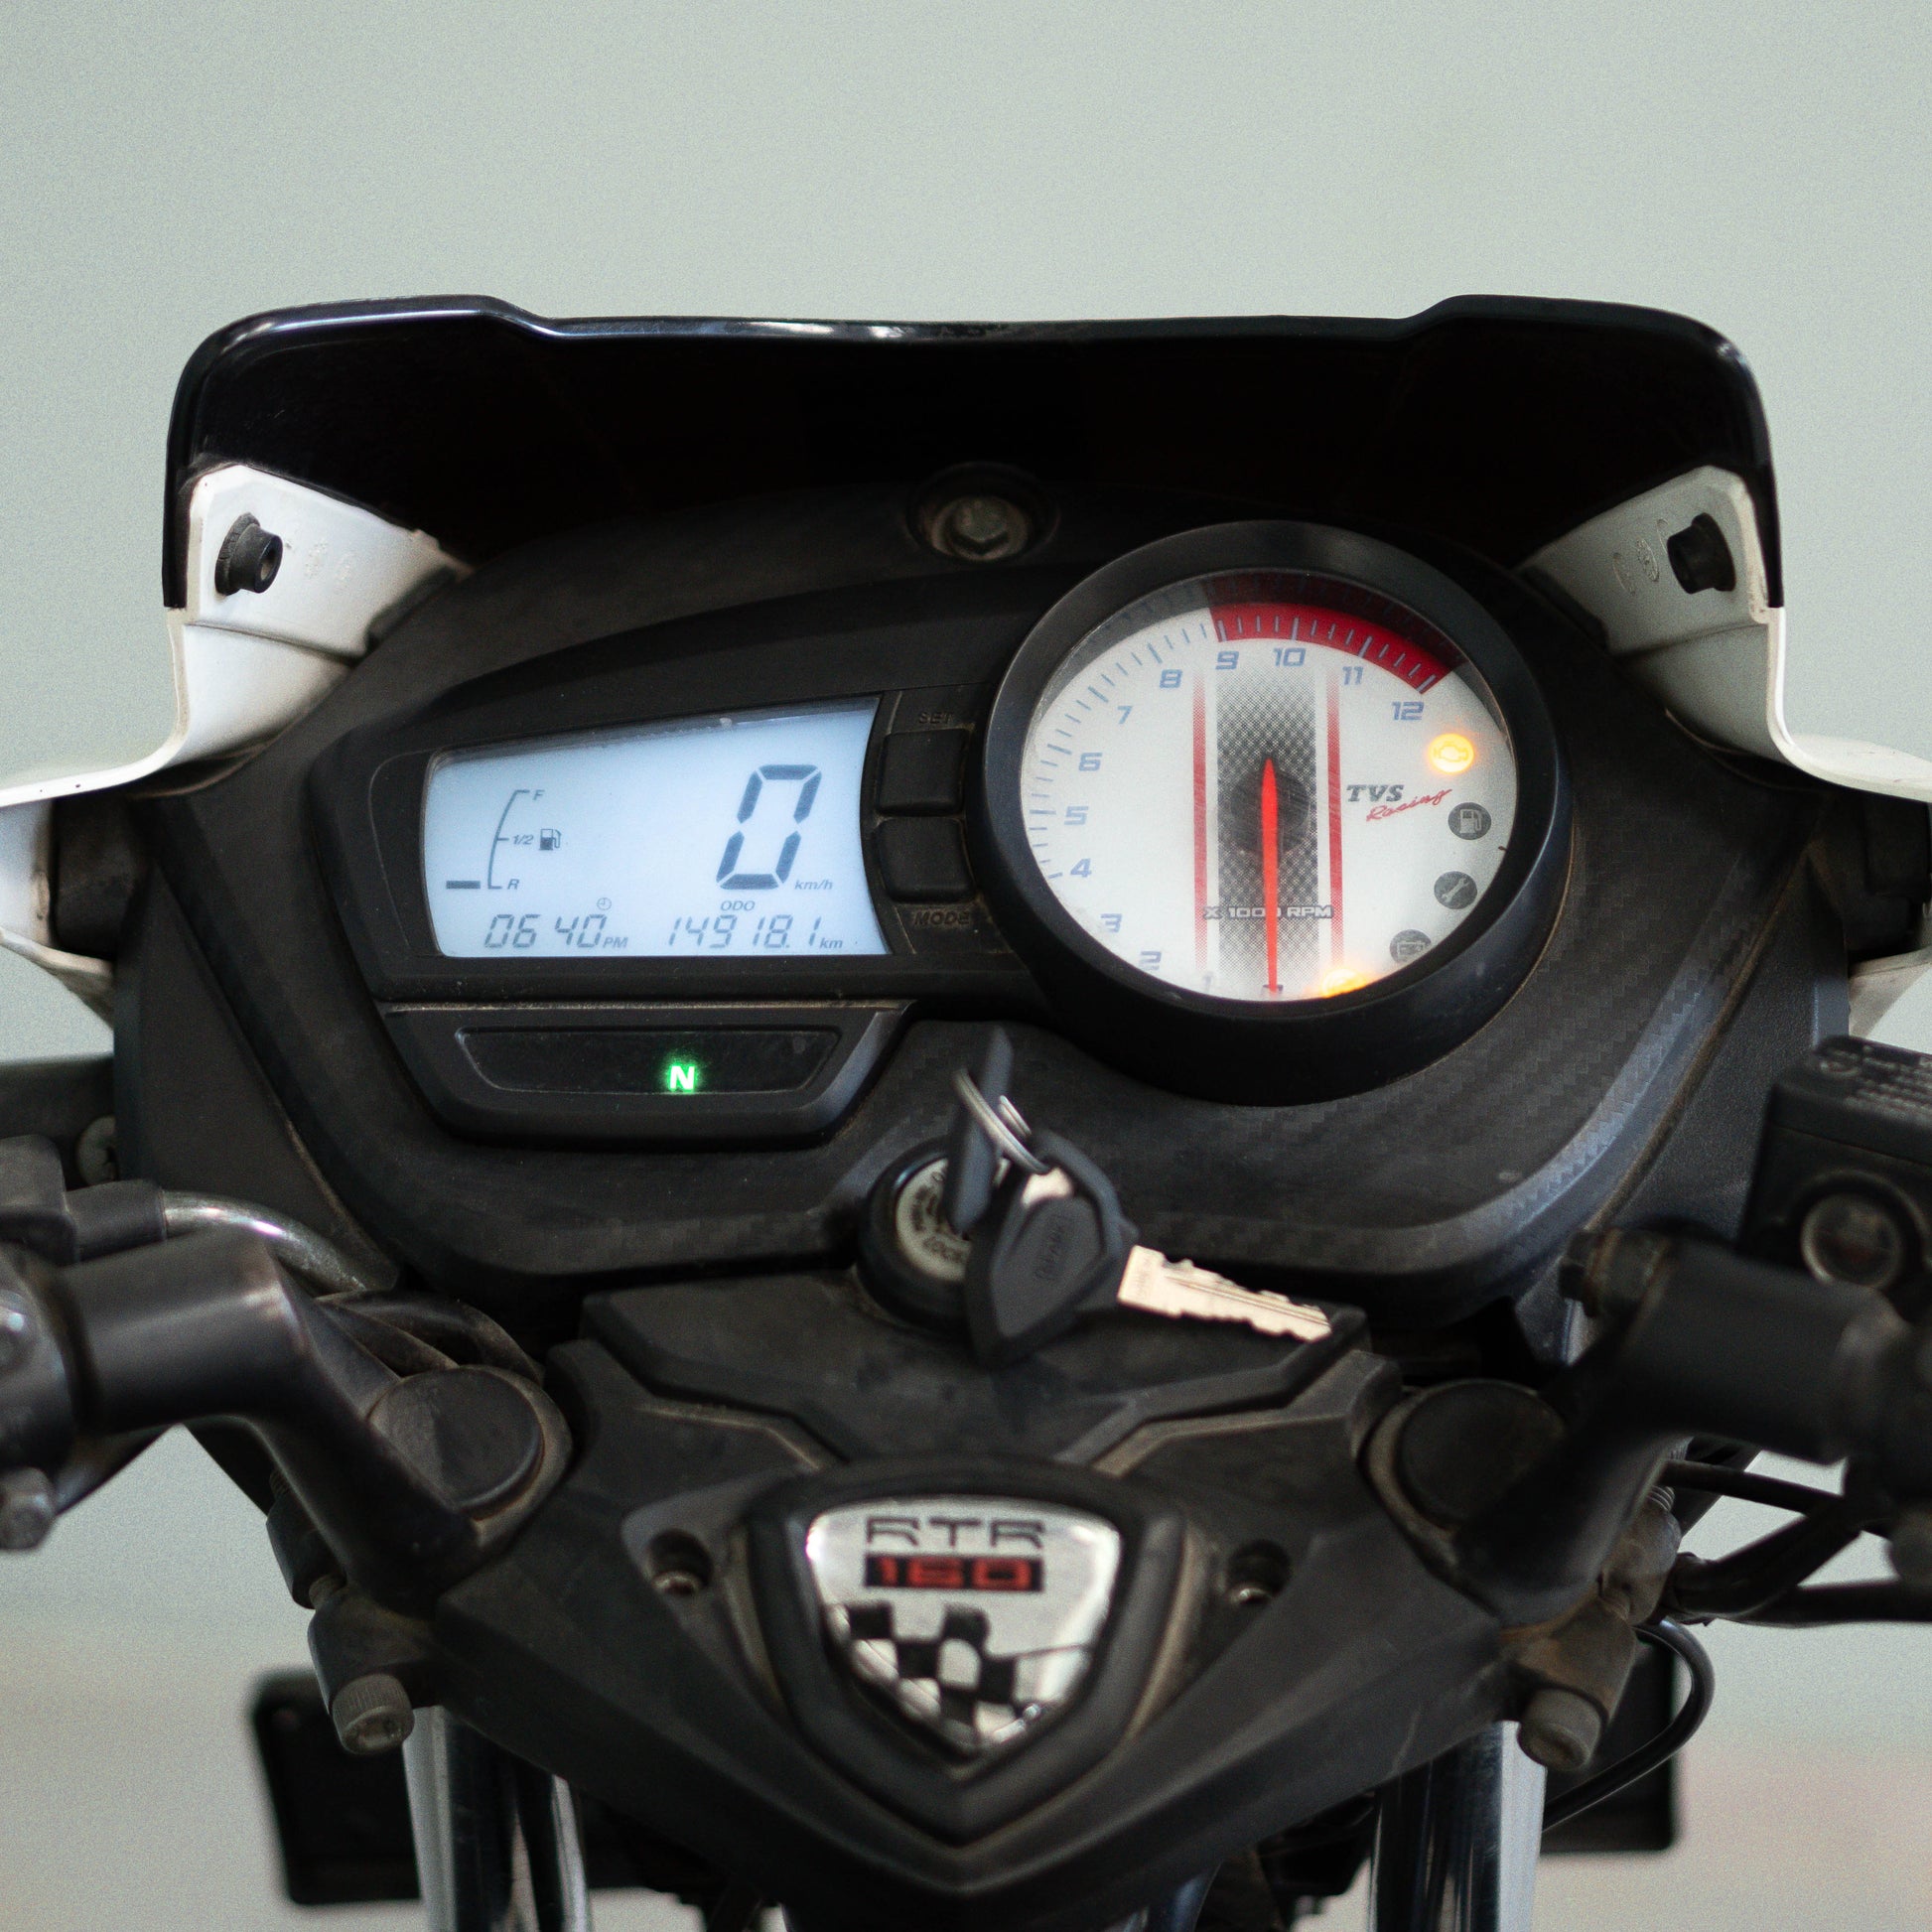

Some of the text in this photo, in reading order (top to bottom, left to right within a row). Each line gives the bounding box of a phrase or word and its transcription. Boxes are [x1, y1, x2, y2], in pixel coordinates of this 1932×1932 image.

[1214, 650, 1240, 670] 9
[1273, 647, 1307, 667] 10
[1159, 669, 1182, 689] 8
[1341, 666, 1364, 686] 11
[1117, 706, 1134, 725] 7
[1391, 701, 1425, 721] 12
[1078, 752, 1103, 771] 6
[532, 790, 544, 801] F
[1346, 784, 1404, 802] TVS
[1366, 788, 1452, 821] Racing
[1064, 806, 1089, 826] 5
[716, 763, 823, 891] 0
[512, 835, 534, 845] 1/2
[1069, 859, 1092, 878] 4
[507, 880, 519, 891] R
[794, 879, 834, 893] km/h
[720, 900, 756, 911] ODO
[1203, 904, 1333, 919] X 100 RPM
[914, 910, 971, 925] MODE
[1100, 913, 1123, 933] 3
[603, 936, 628, 949] PM
[819, 937, 843, 950] km
[1140, 950, 1163, 970] 2
[669, 1064, 696, 1091] N
[866, 1516, 1045, 1550] RTR
[874, 1556, 1035, 1587] 160
